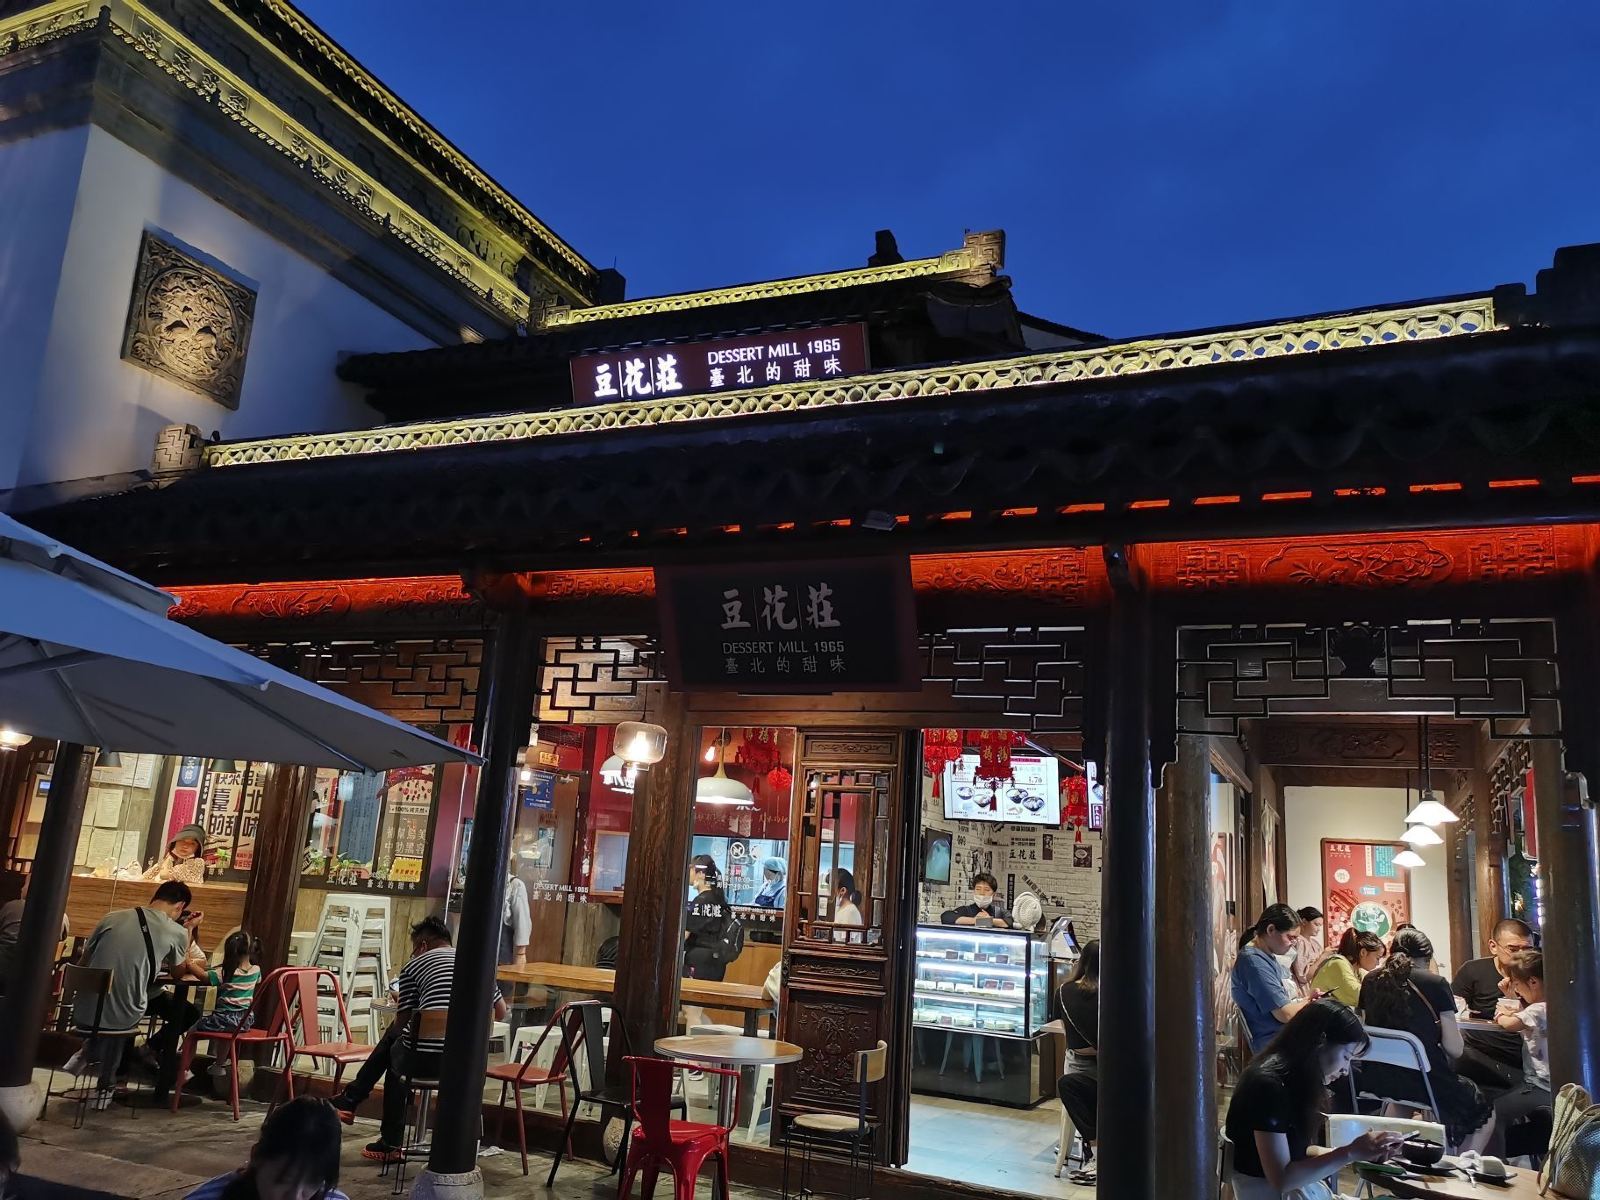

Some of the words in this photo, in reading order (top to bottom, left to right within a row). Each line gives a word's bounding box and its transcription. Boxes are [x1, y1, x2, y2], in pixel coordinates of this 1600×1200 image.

[708, 346, 764, 365] DESSERT
[768, 342, 801, 358] MILL
[807, 338, 841, 354] 1965
[594, 354, 683, 398] 豆花莊
[709, 354, 842, 387] 臺北的甜味
[721, 582, 841, 631] 豆花莊
[722, 641, 774, 655] DESSERT
[778, 641, 808, 653] MILL
[814, 640, 845, 653] 1965
[725, 655, 847, 675] 臺北的甜味
[559, 884, 573, 892] MILL
